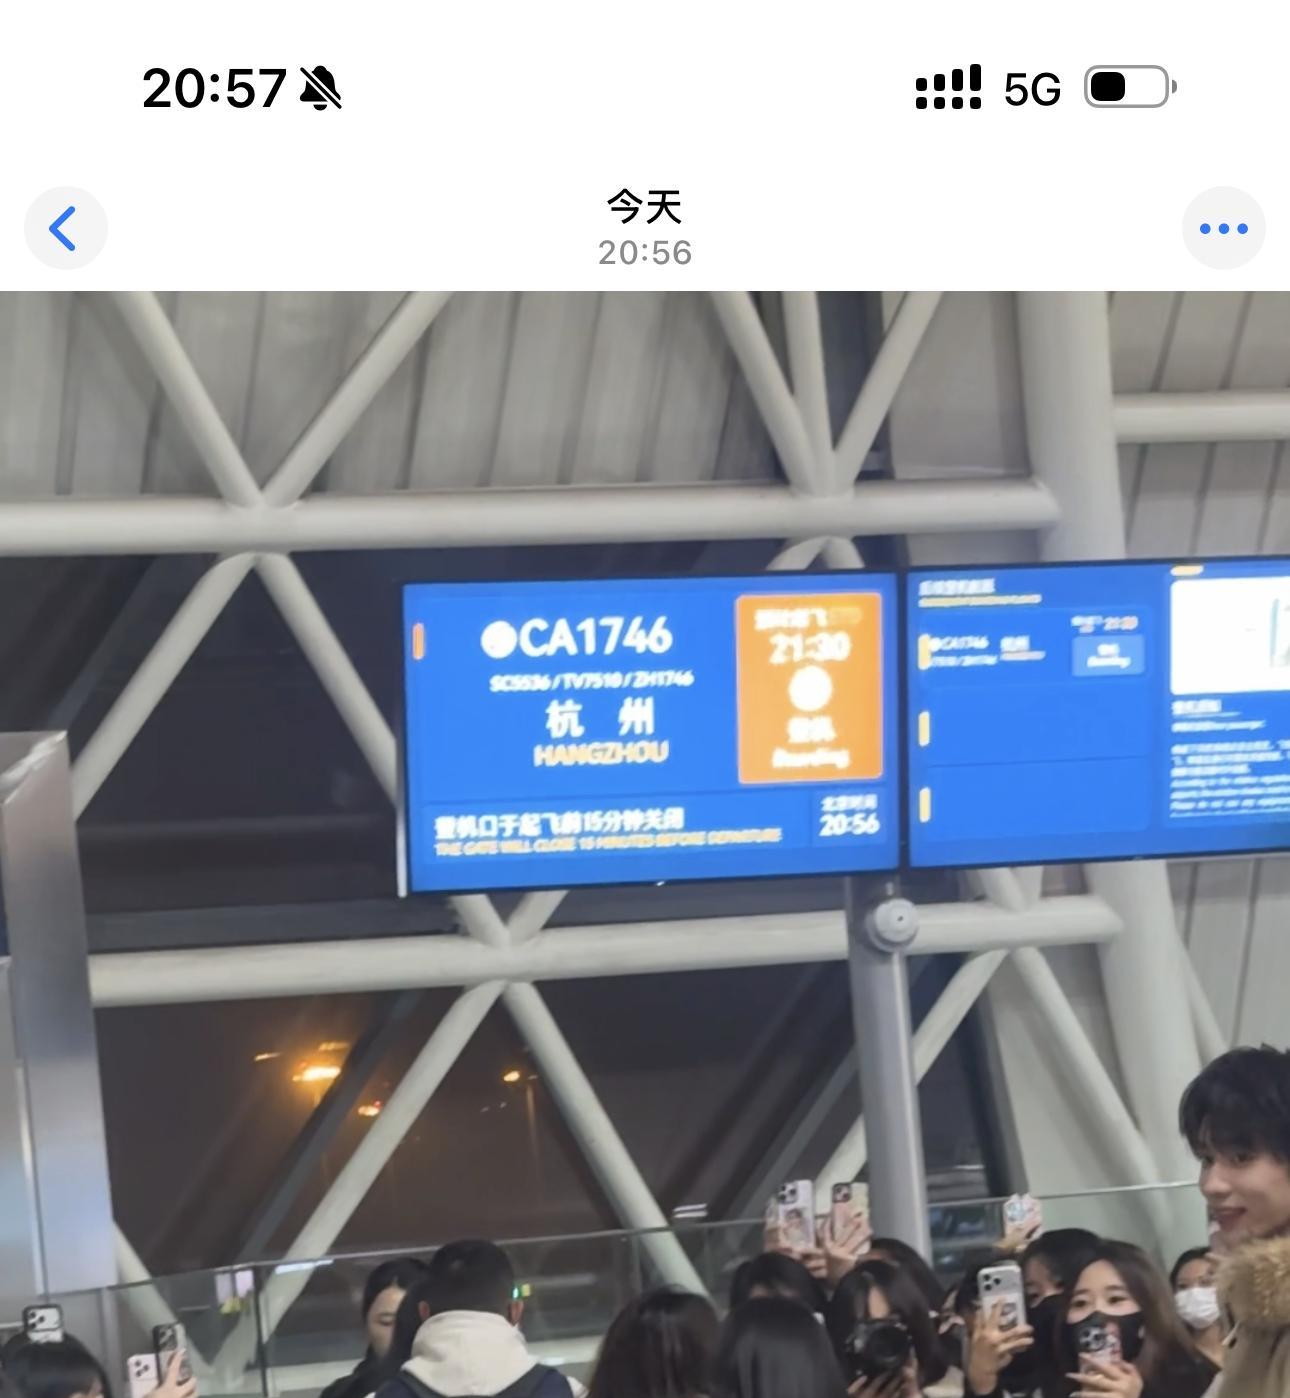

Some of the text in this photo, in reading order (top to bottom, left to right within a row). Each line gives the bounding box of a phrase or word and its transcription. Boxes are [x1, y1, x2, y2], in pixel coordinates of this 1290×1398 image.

[519, 615, 673, 657] CA1746
[769, 630, 851, 664] 21:30
[533, 740, 669, 767] HANGZHOU
[819, 812, 881, 837] 20:56
